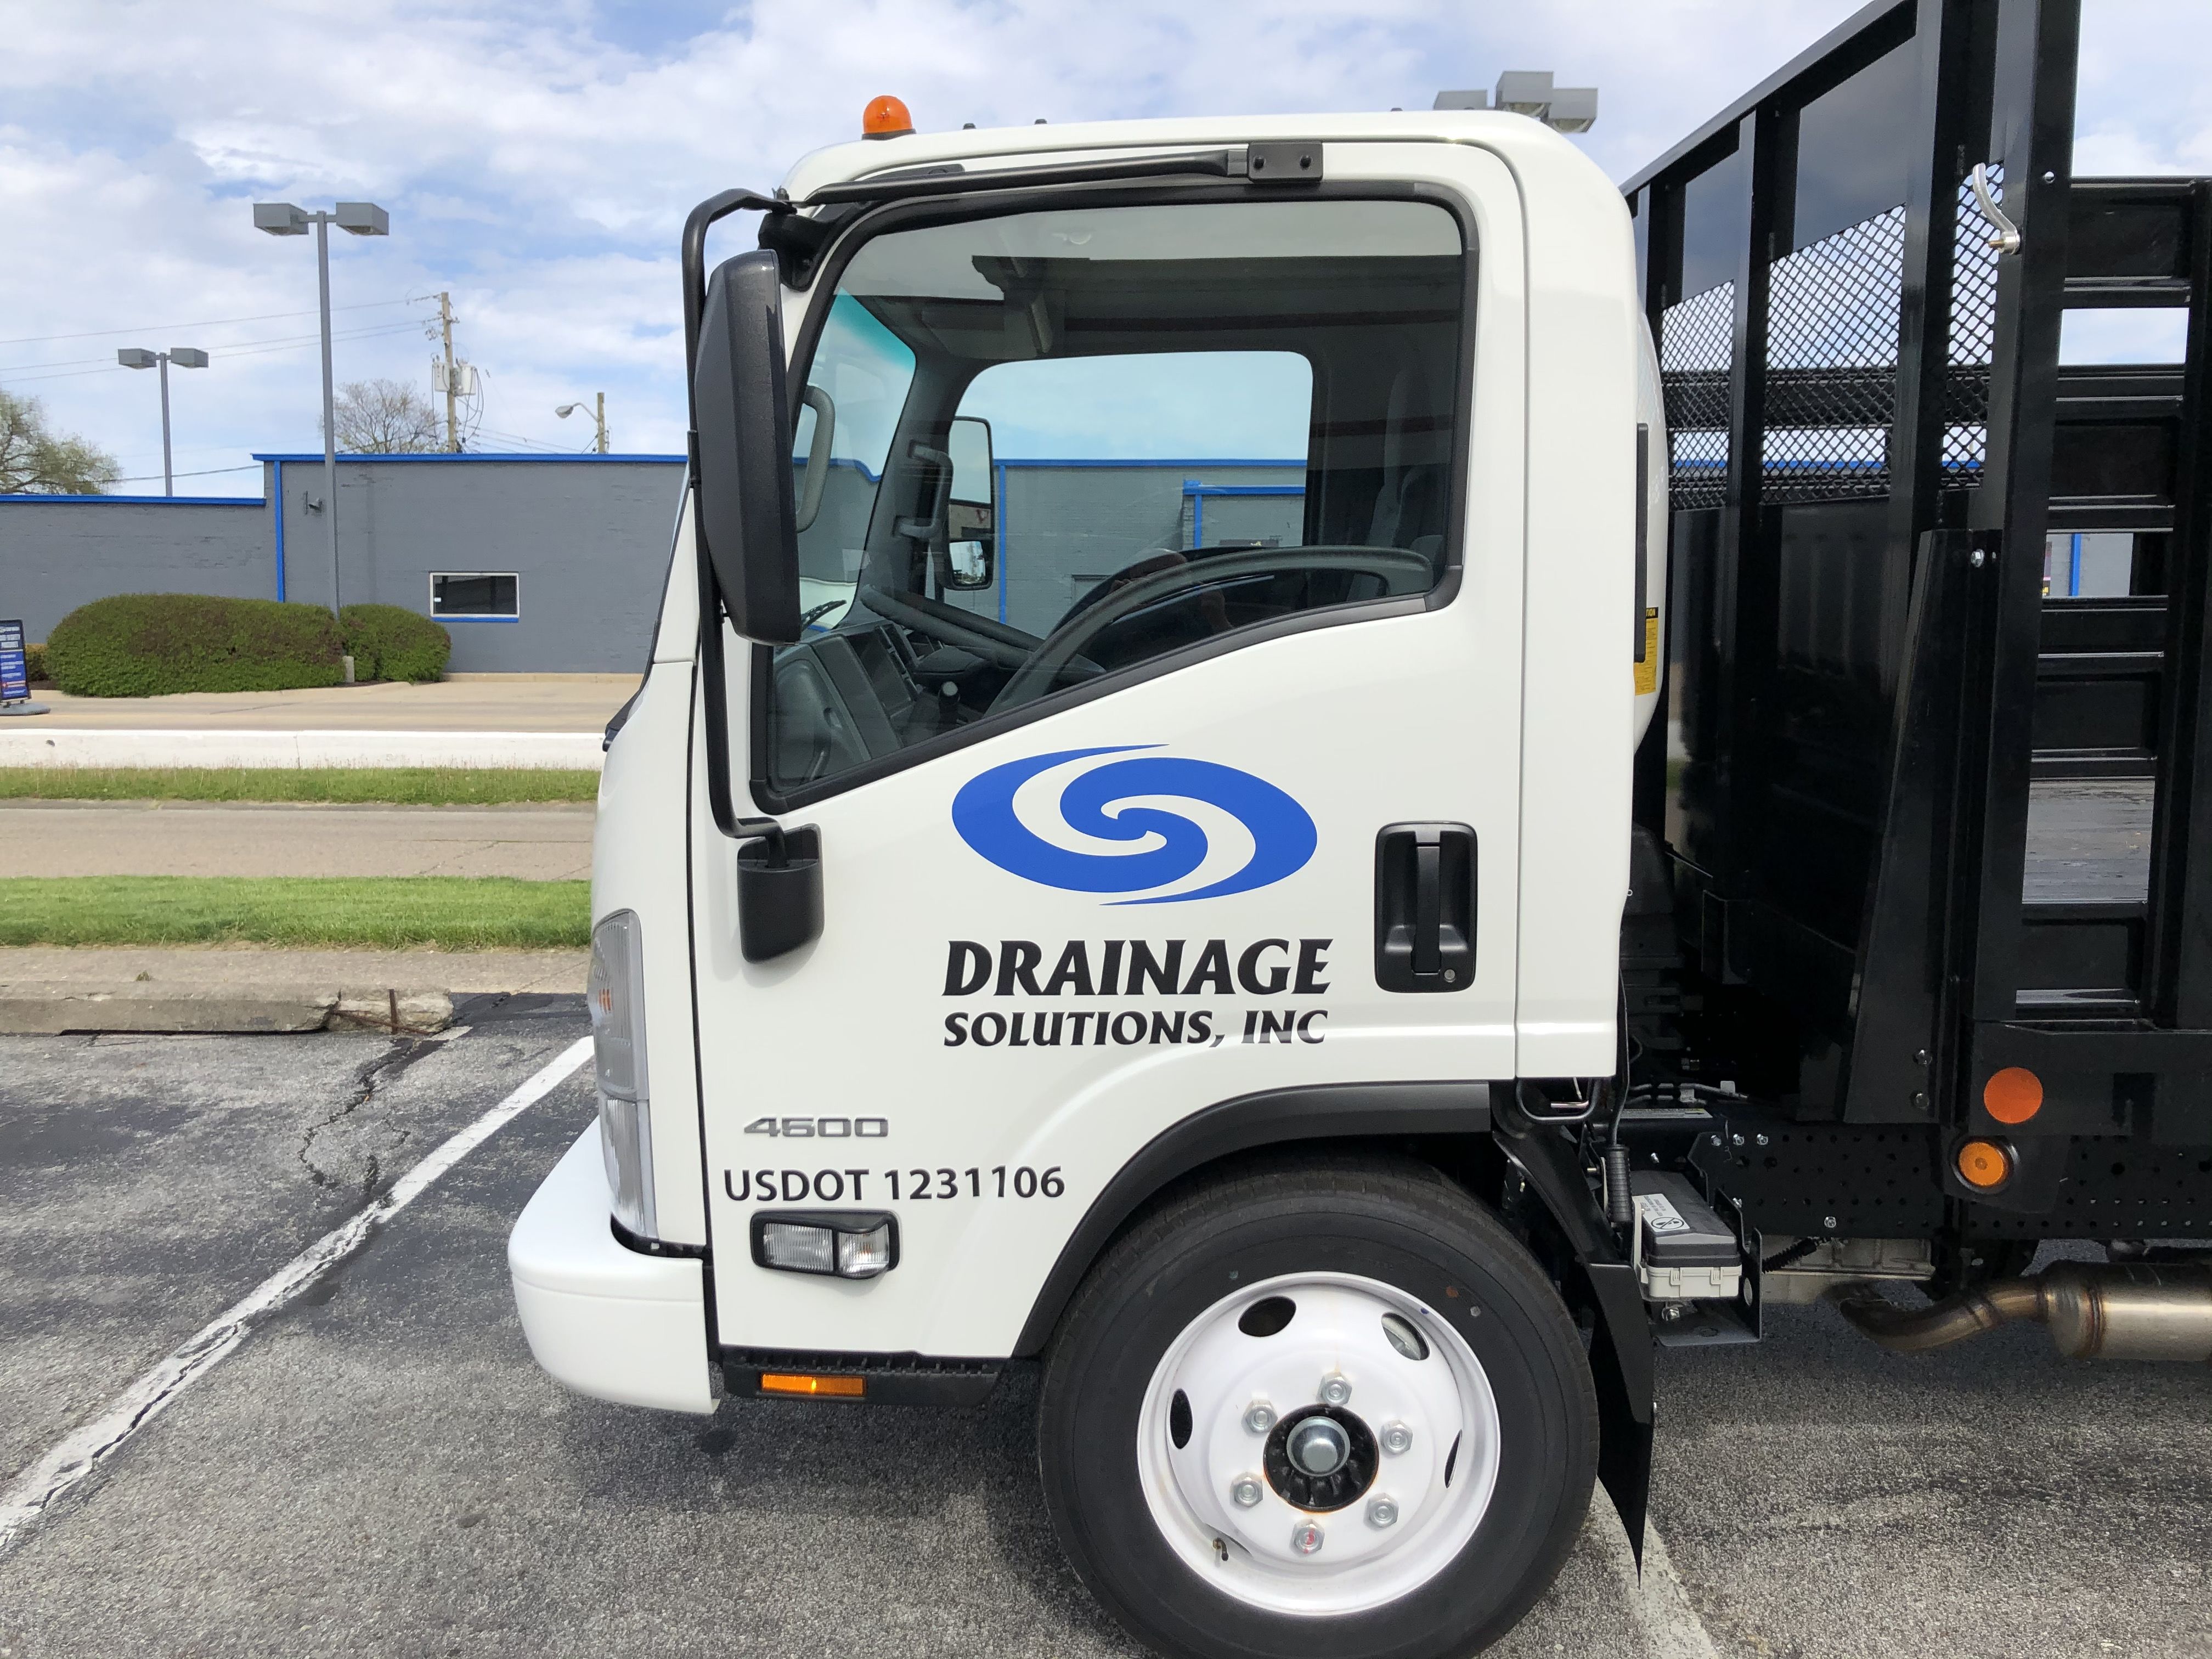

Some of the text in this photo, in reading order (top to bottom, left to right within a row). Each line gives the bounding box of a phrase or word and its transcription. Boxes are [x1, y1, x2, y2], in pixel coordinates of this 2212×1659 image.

[941, 938, 1334, 996] DRAINAGE
[944, 1009, 1329, 1048] SOLUTIONS, INC
[724, 1166, 1065, 1201] USDOT 1231106
